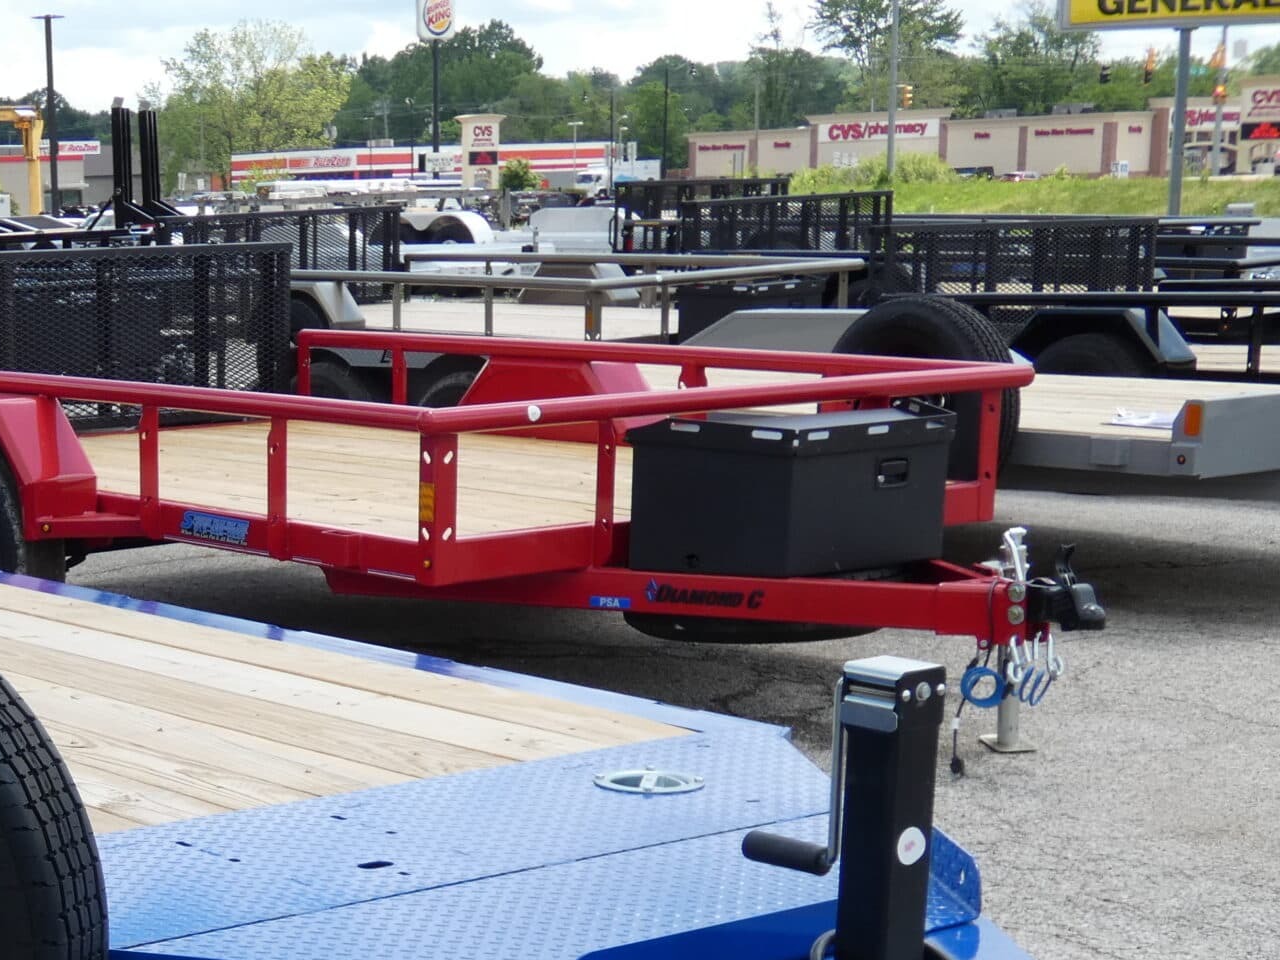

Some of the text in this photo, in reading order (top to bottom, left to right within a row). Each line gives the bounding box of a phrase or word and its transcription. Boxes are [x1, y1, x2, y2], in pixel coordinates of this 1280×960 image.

[1098, 0, 1280, 15] GENE
[428, 8, 451, 26] KING
[1252, 89, 1280, 104] CV
[473, 125, 493, 137] CVS
[828, 121, 928, 140] CVS/phamacy
[599, 597, 620, 608] PSA
[747, 591, 764, 609] C
